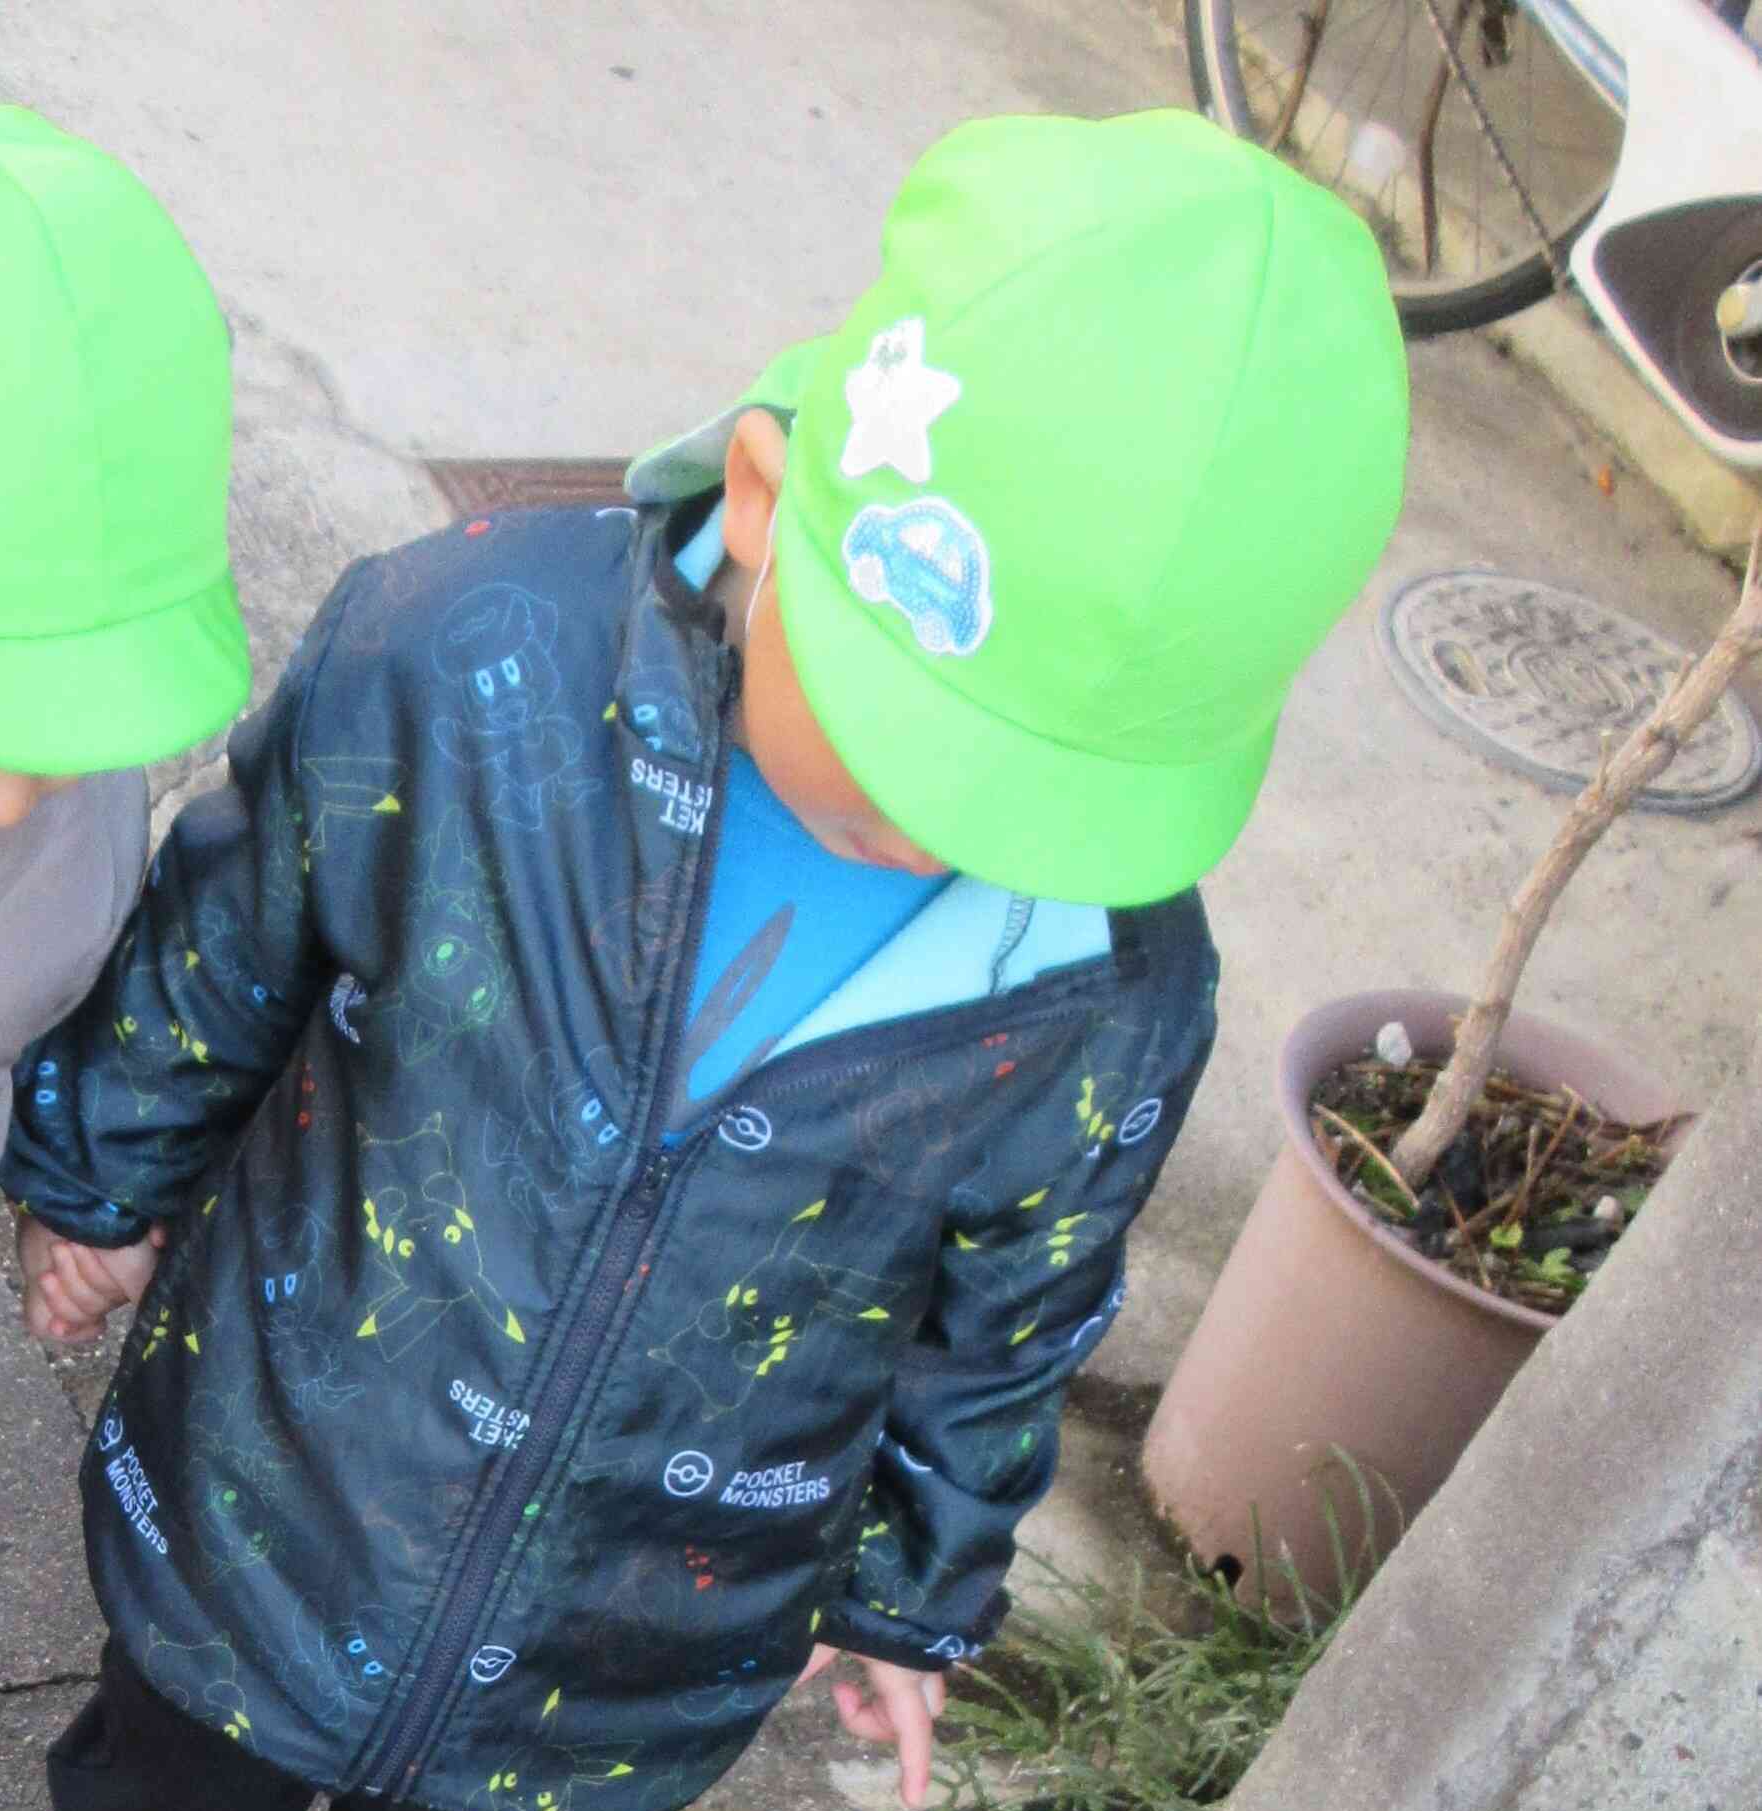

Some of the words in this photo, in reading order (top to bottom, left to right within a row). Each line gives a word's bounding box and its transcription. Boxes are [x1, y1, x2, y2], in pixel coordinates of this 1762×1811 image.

[122, 1445, 158, 1514] POCKET
[719, 1476, 831, 1508] MONSTERS
[730, 1460, 807, 1489] POCKET
[105, 1459, 168, 1554] MONSTERS
